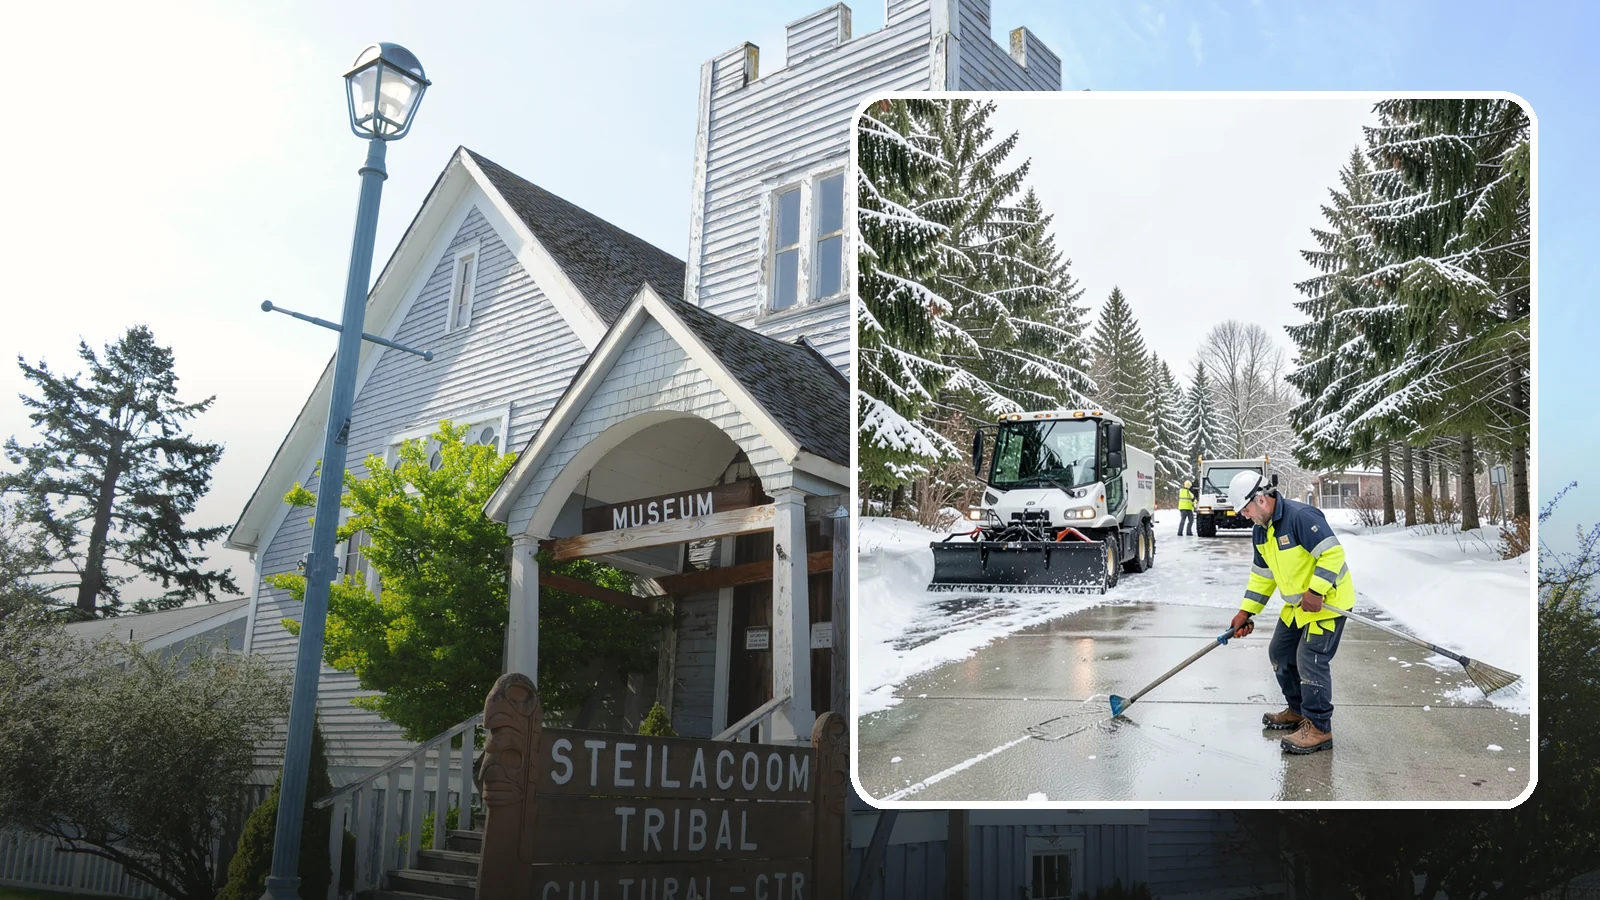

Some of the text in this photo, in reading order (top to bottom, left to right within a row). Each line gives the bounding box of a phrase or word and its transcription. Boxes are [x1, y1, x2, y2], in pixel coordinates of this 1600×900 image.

[613, 491, 713, 531] MUSEUM
[550, 738, 809, 793] STEILACOOM
[615, 806, 758, 852] TRIBAL
